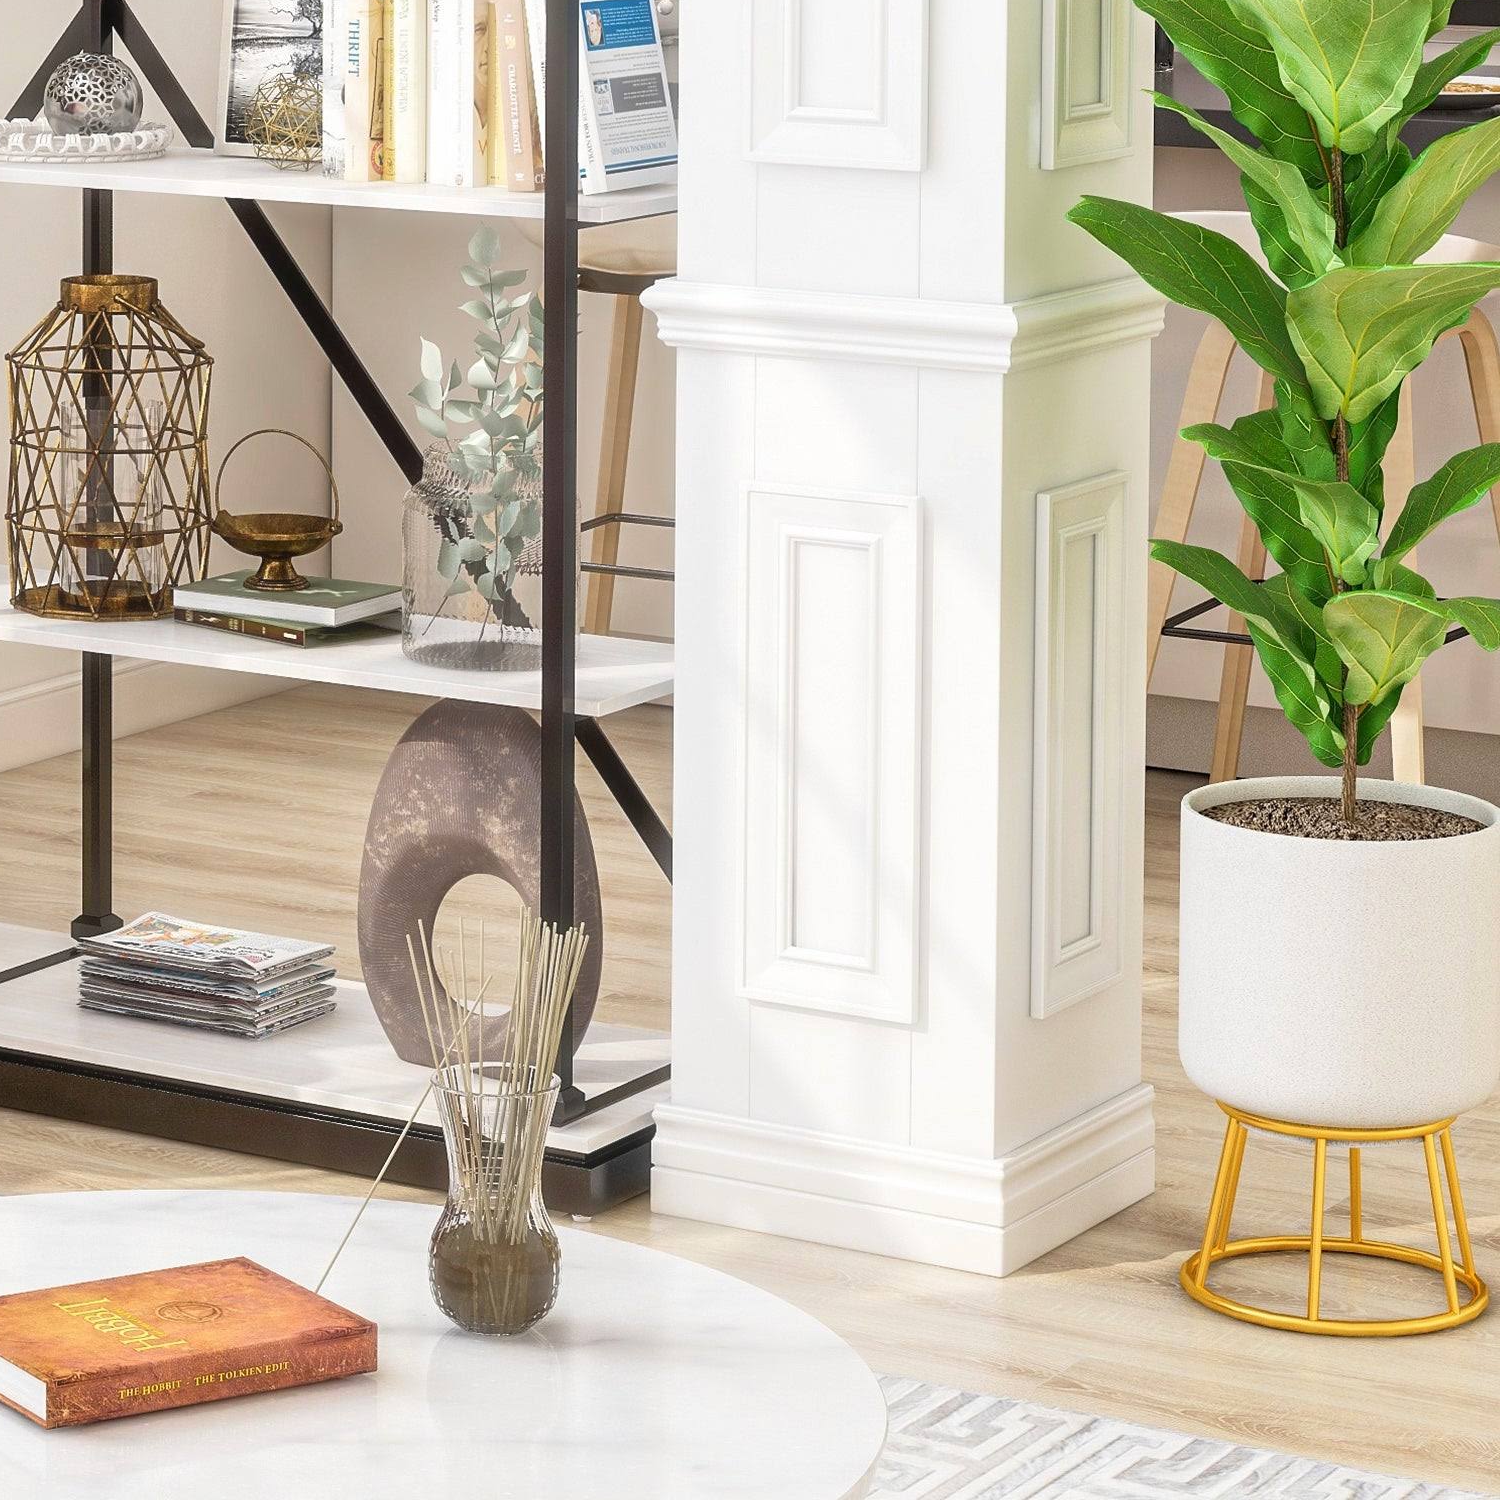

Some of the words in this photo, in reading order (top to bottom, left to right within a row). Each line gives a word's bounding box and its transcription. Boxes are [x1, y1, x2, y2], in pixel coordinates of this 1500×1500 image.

[348, 19, 361, 78] THRIFT
[507, 64, 519, 117] CHARLOTTE
[52, 1297, 188, 1352] HOBBIT
[118, 1387, 140, 1400] THE
[141, 1379, 183, 1396] HOBBIT
[194, 1373, 216, 1387] THE
[217, 1365, 263, 1383] TOLKIEN
[264, 1360, 291, 1374] EDIT
